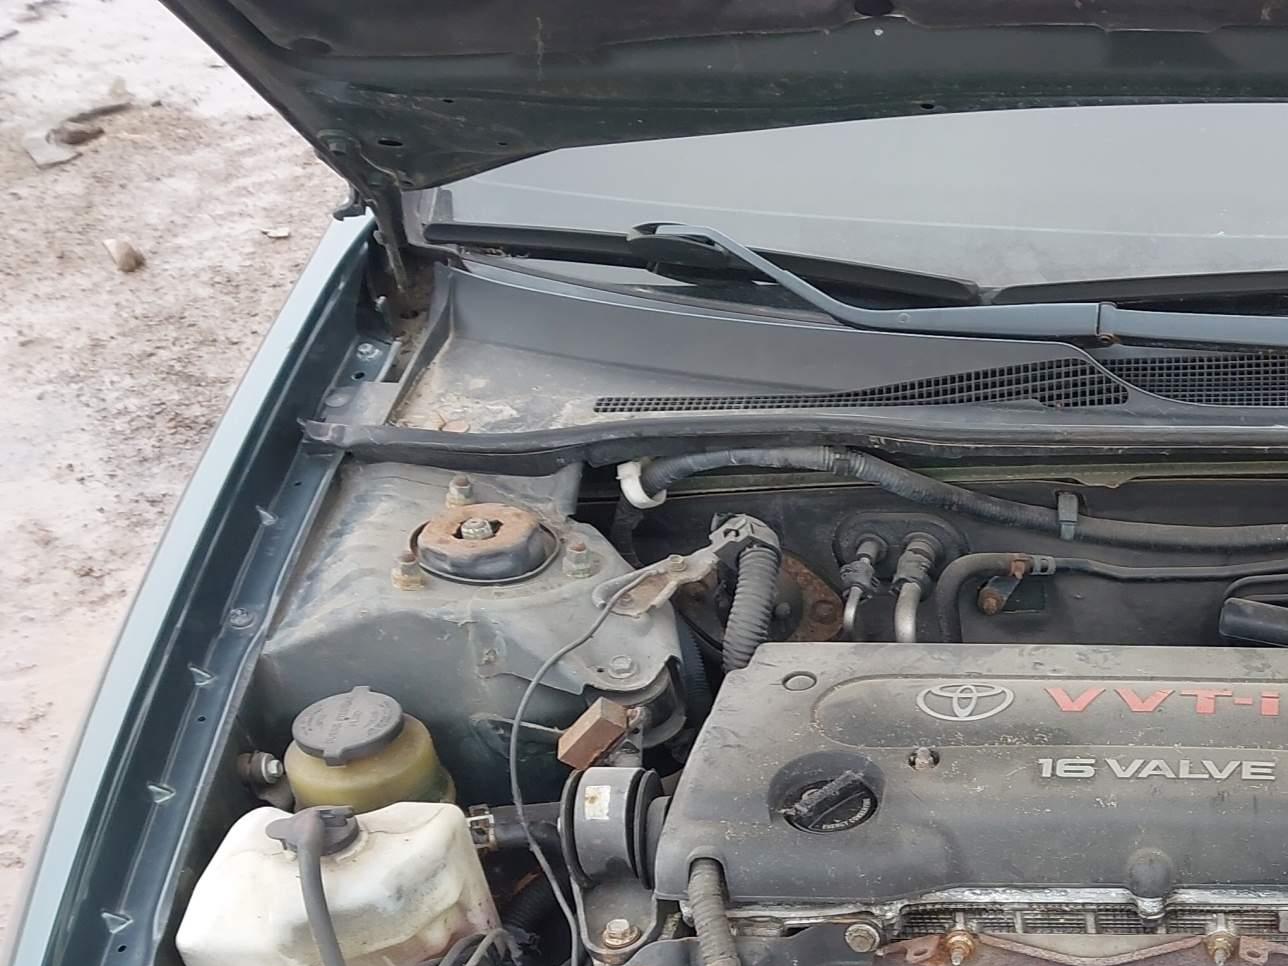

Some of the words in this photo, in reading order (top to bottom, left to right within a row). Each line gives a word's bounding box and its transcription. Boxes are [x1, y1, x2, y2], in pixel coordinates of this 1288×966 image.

[1043, 687, 1281, 717] VVT-i
[1037, 758, 1097, 779] 16
[1104, 759, 1277, 782] VALVE
